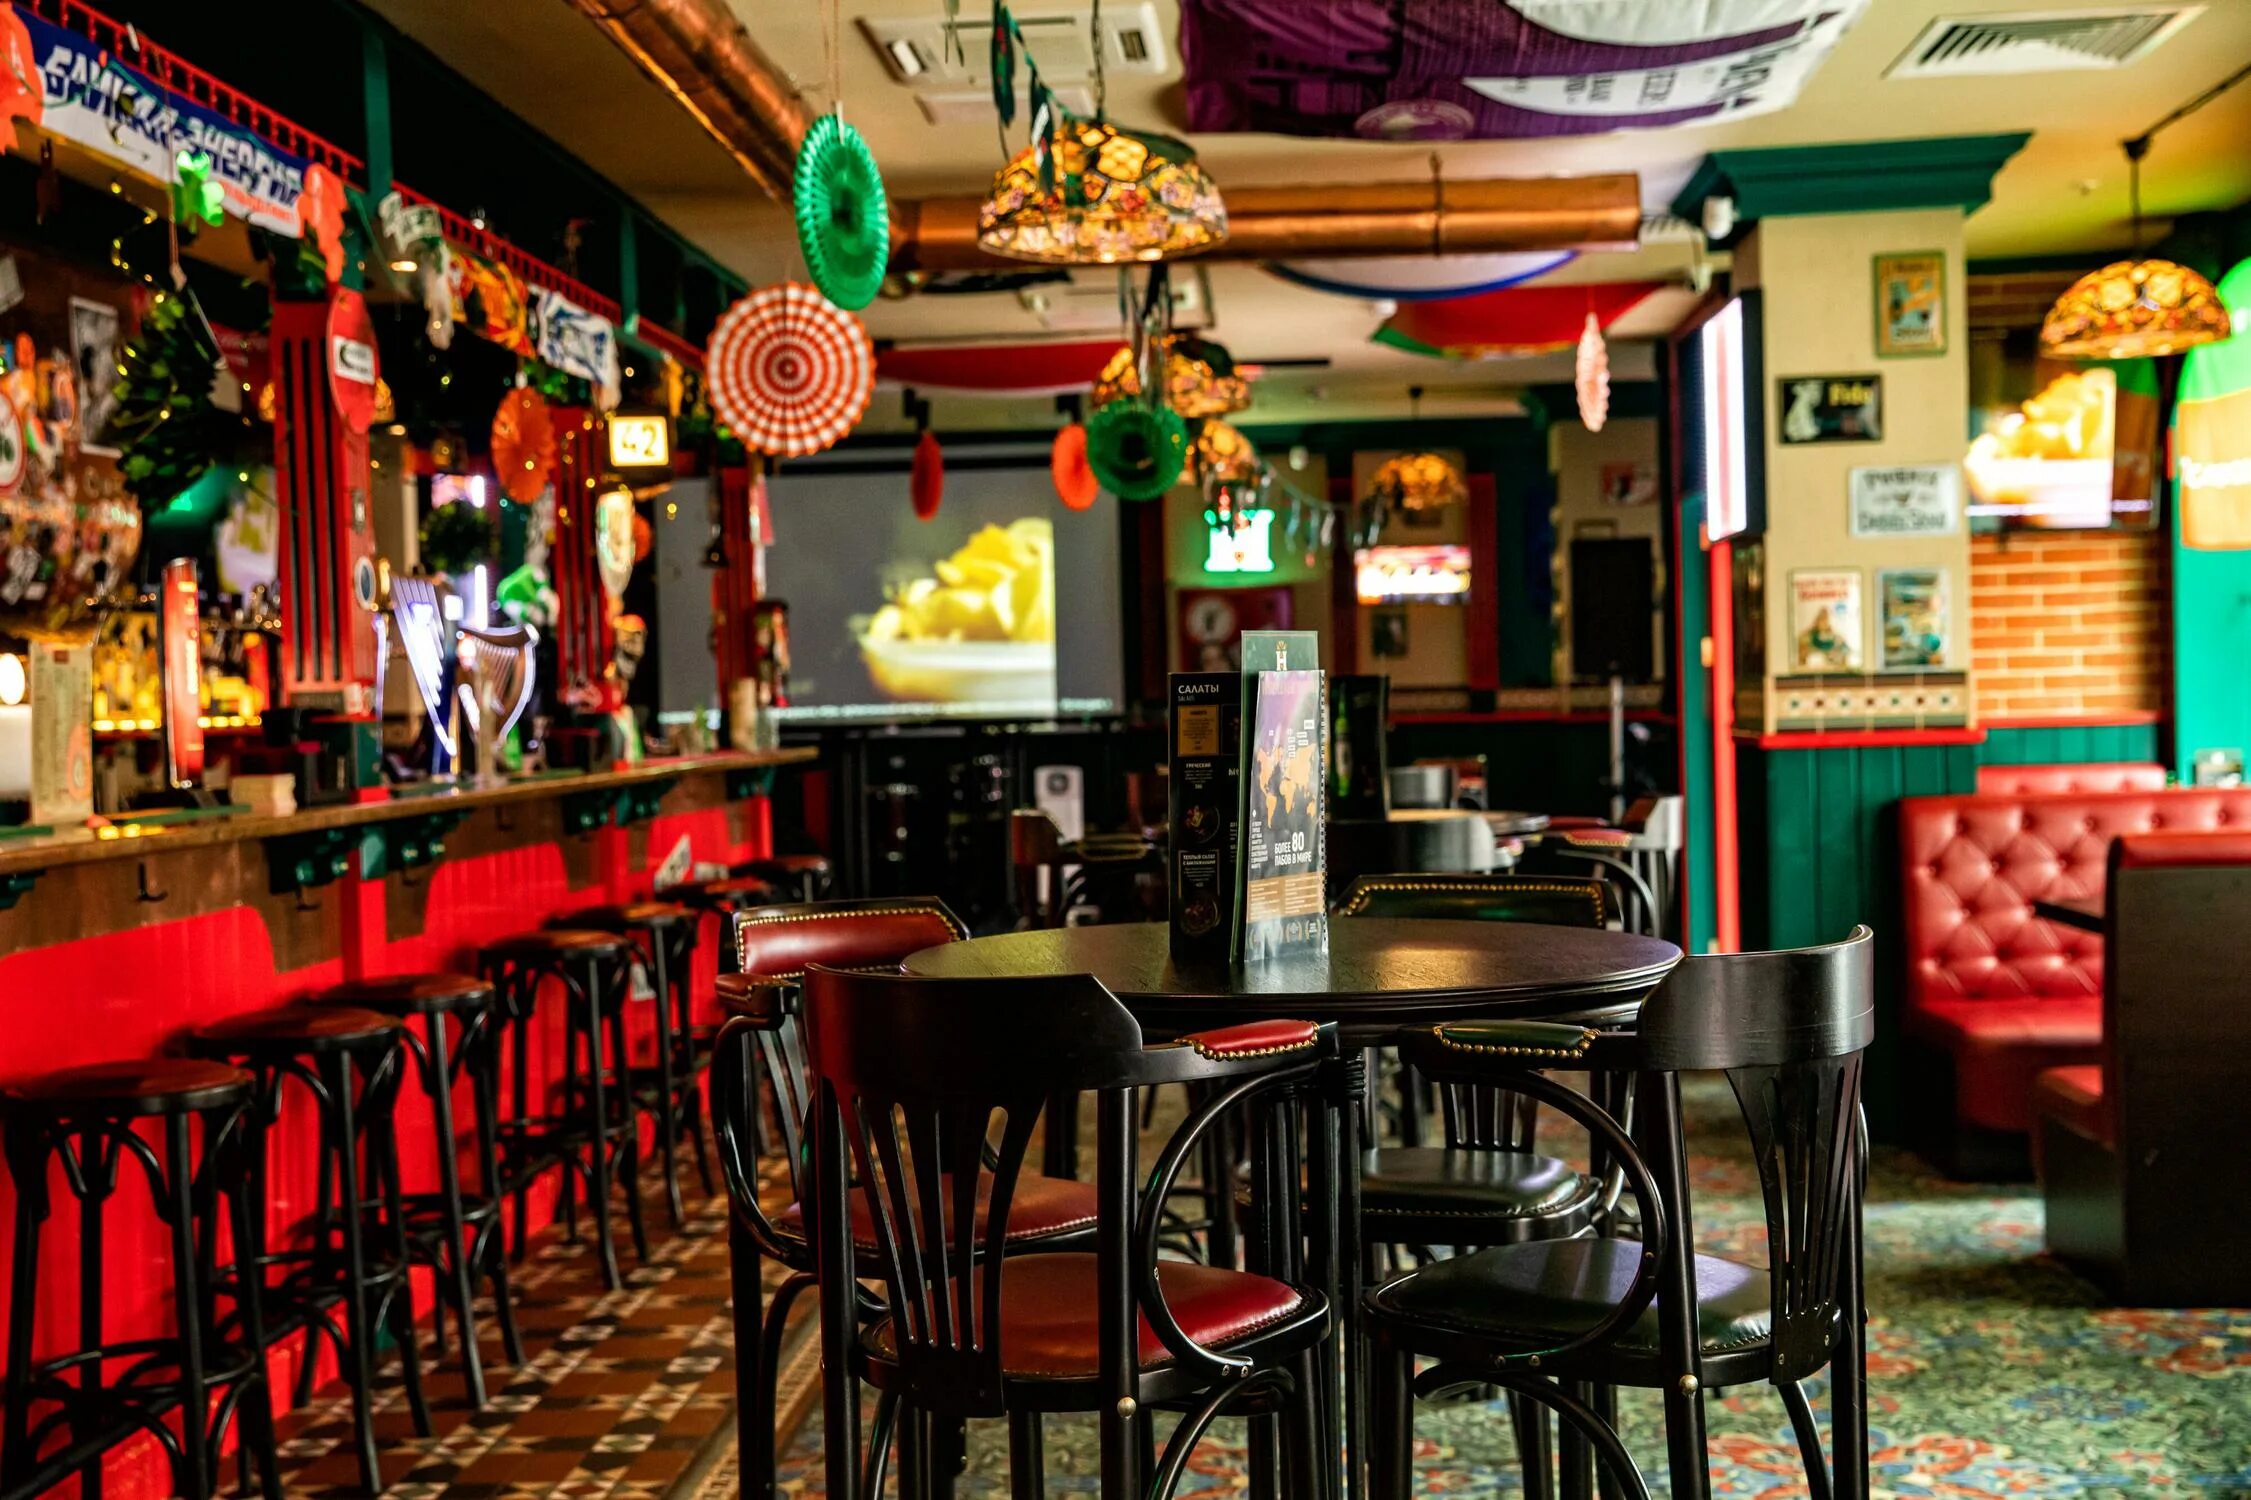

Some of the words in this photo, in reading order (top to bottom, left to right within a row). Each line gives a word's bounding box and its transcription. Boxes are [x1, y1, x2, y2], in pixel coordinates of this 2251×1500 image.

[621, 424, 657, 457] 42
[1178, 684, 1219, 694] САЛАТЫ
[1275, 841, 1291, 855] БОЛЕЕ
[1292, 831, 1305, 852] 80
[1274, 854, 1292, 867] ПАБОВ
[1292, 853, 1297, 865] В
[1297, 850, 1313, 864] МИРЕ
